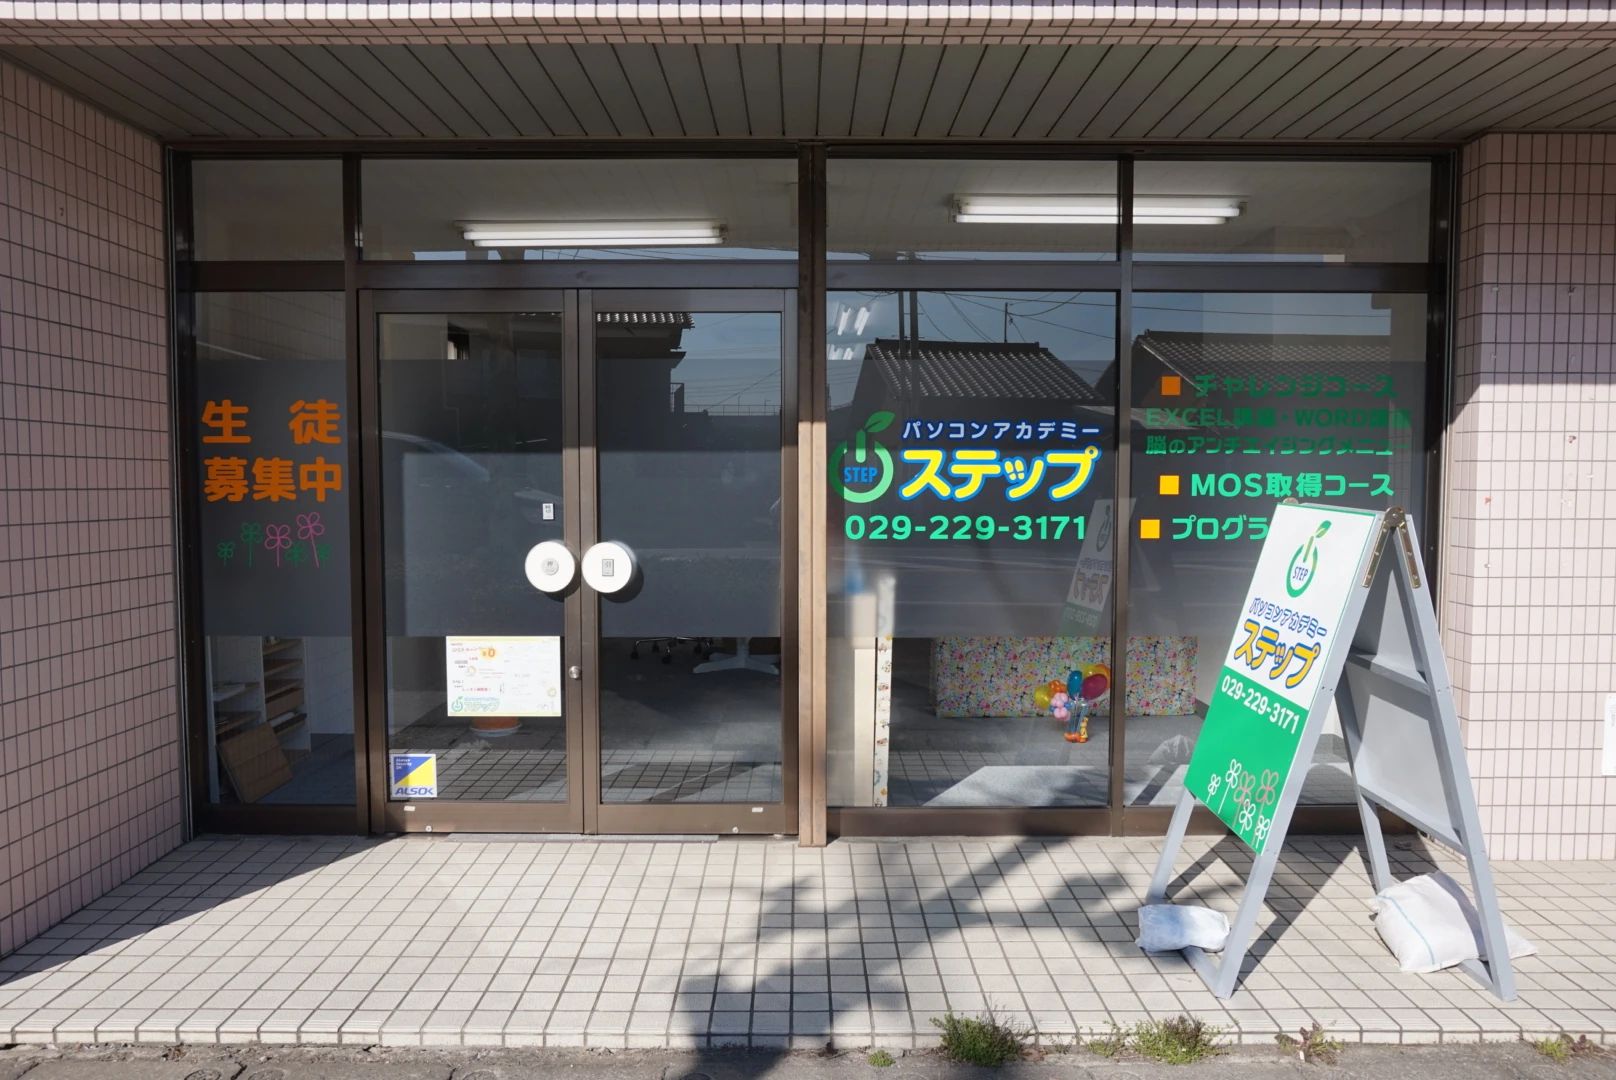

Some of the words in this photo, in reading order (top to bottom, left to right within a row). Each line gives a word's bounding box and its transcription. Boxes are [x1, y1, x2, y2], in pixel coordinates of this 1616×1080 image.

[1194, 374, 1397, 398] チャレンジコース
[902, 420, 1100, 440] パソコンアカデミー
[203, 456, 342, 502] 募集中
[843, 466, 878, 484] STEP
[899, 445, 1101, 500] ステップ
[1191, 473, 1394, 498] MOS取得コース
[845, 515, 1086, 541] 029-229-3171
[1292, 566, 1309, 582] STEP
[1248, 597, 1328, 639] パソコンアカデミー
[1233, 618, 1321, 689] ステップ
[1220, 674, 1300, 735] 029-229-3171
[394, 787, 434, 796] ALSOK
